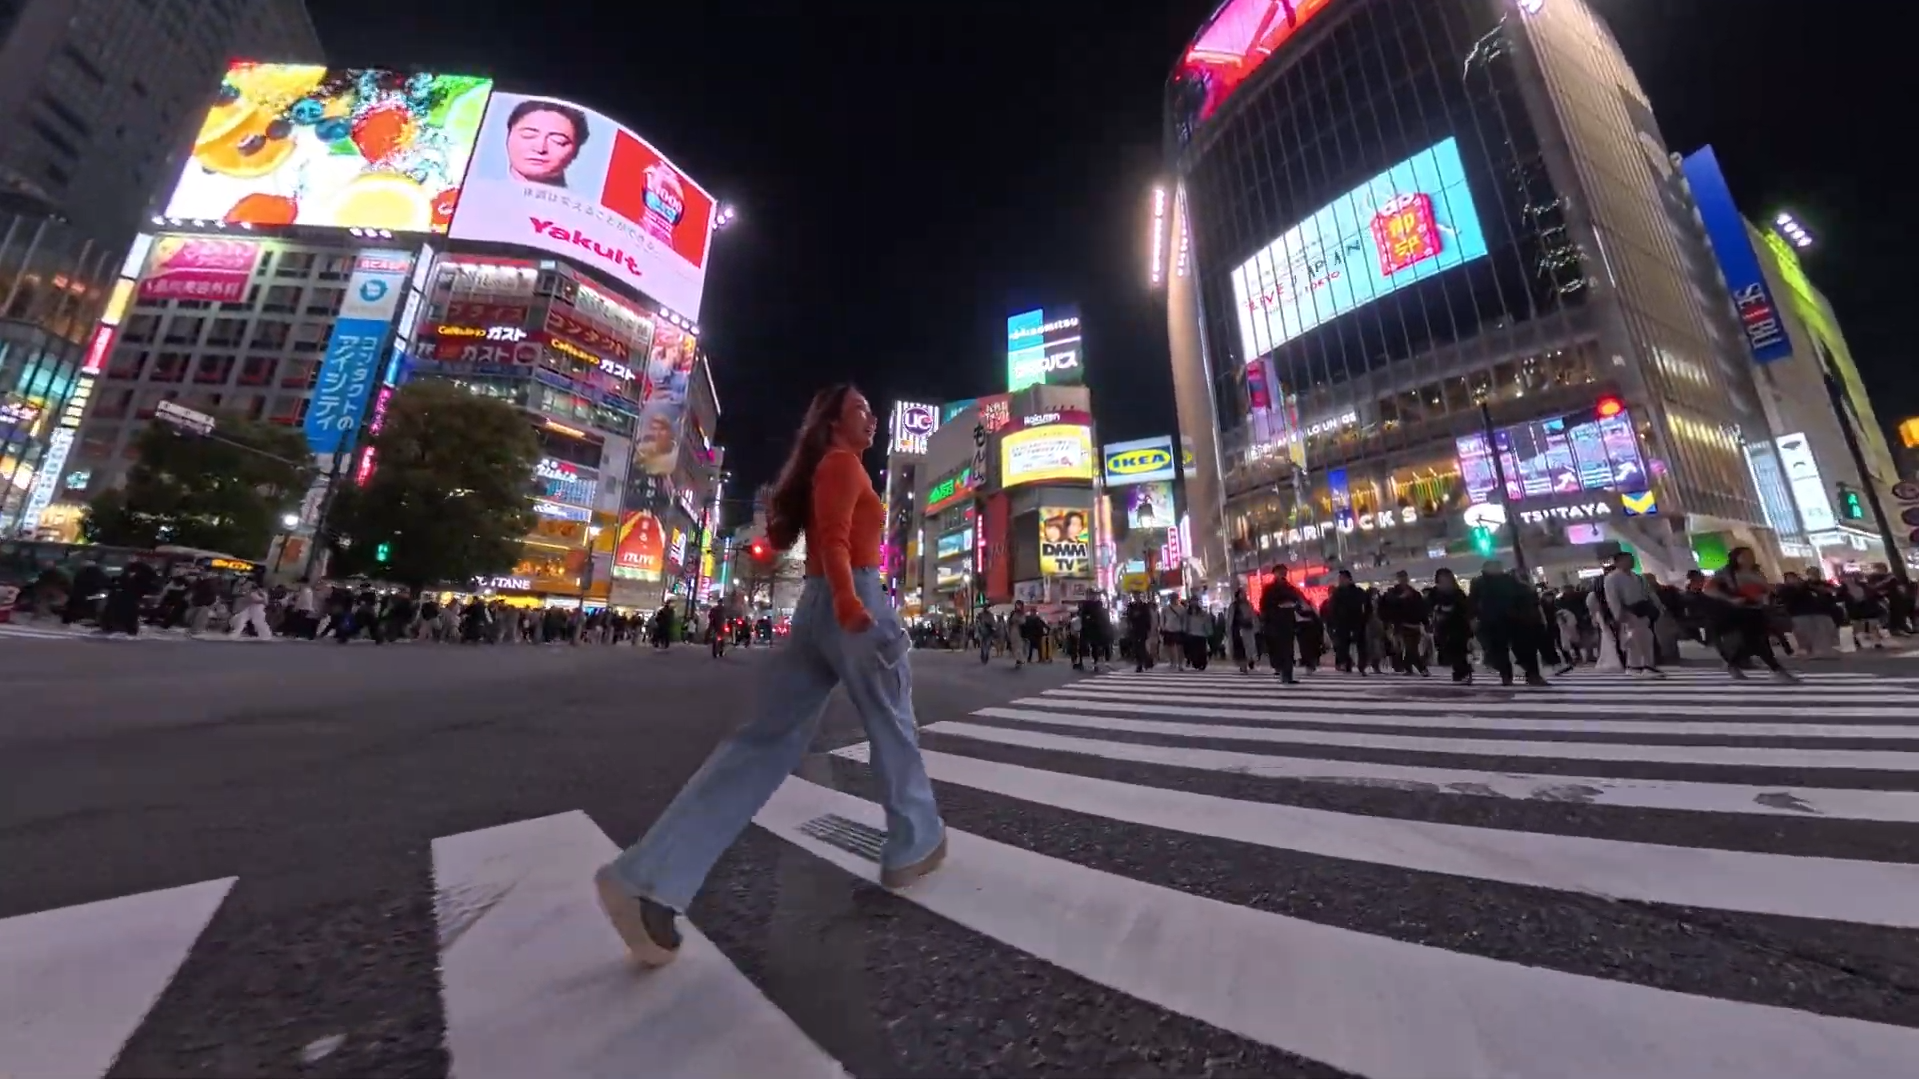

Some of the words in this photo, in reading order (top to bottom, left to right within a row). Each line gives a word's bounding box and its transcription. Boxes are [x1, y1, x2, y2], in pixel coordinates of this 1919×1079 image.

[529, 216, 643, 277] Yakult
[1733, 282, 1783, 349] SEIBU
[486, 325, 527, 342] ガスト
[461, 344, 510, 362] ガスト
[599, 358, 636, 381] ガスト
[315, 334, 360, 431] アイシティ
[336, 336, 378, 431] コンタクトの
[904, 412, 933, 430] UC
[1023, 412, 1061, 427] Rakuten
[1112, 454, 1166, 469] IKEA
[1042, 543, 1086, 557] DMM
[1055, 558, 1074, 571] TV
